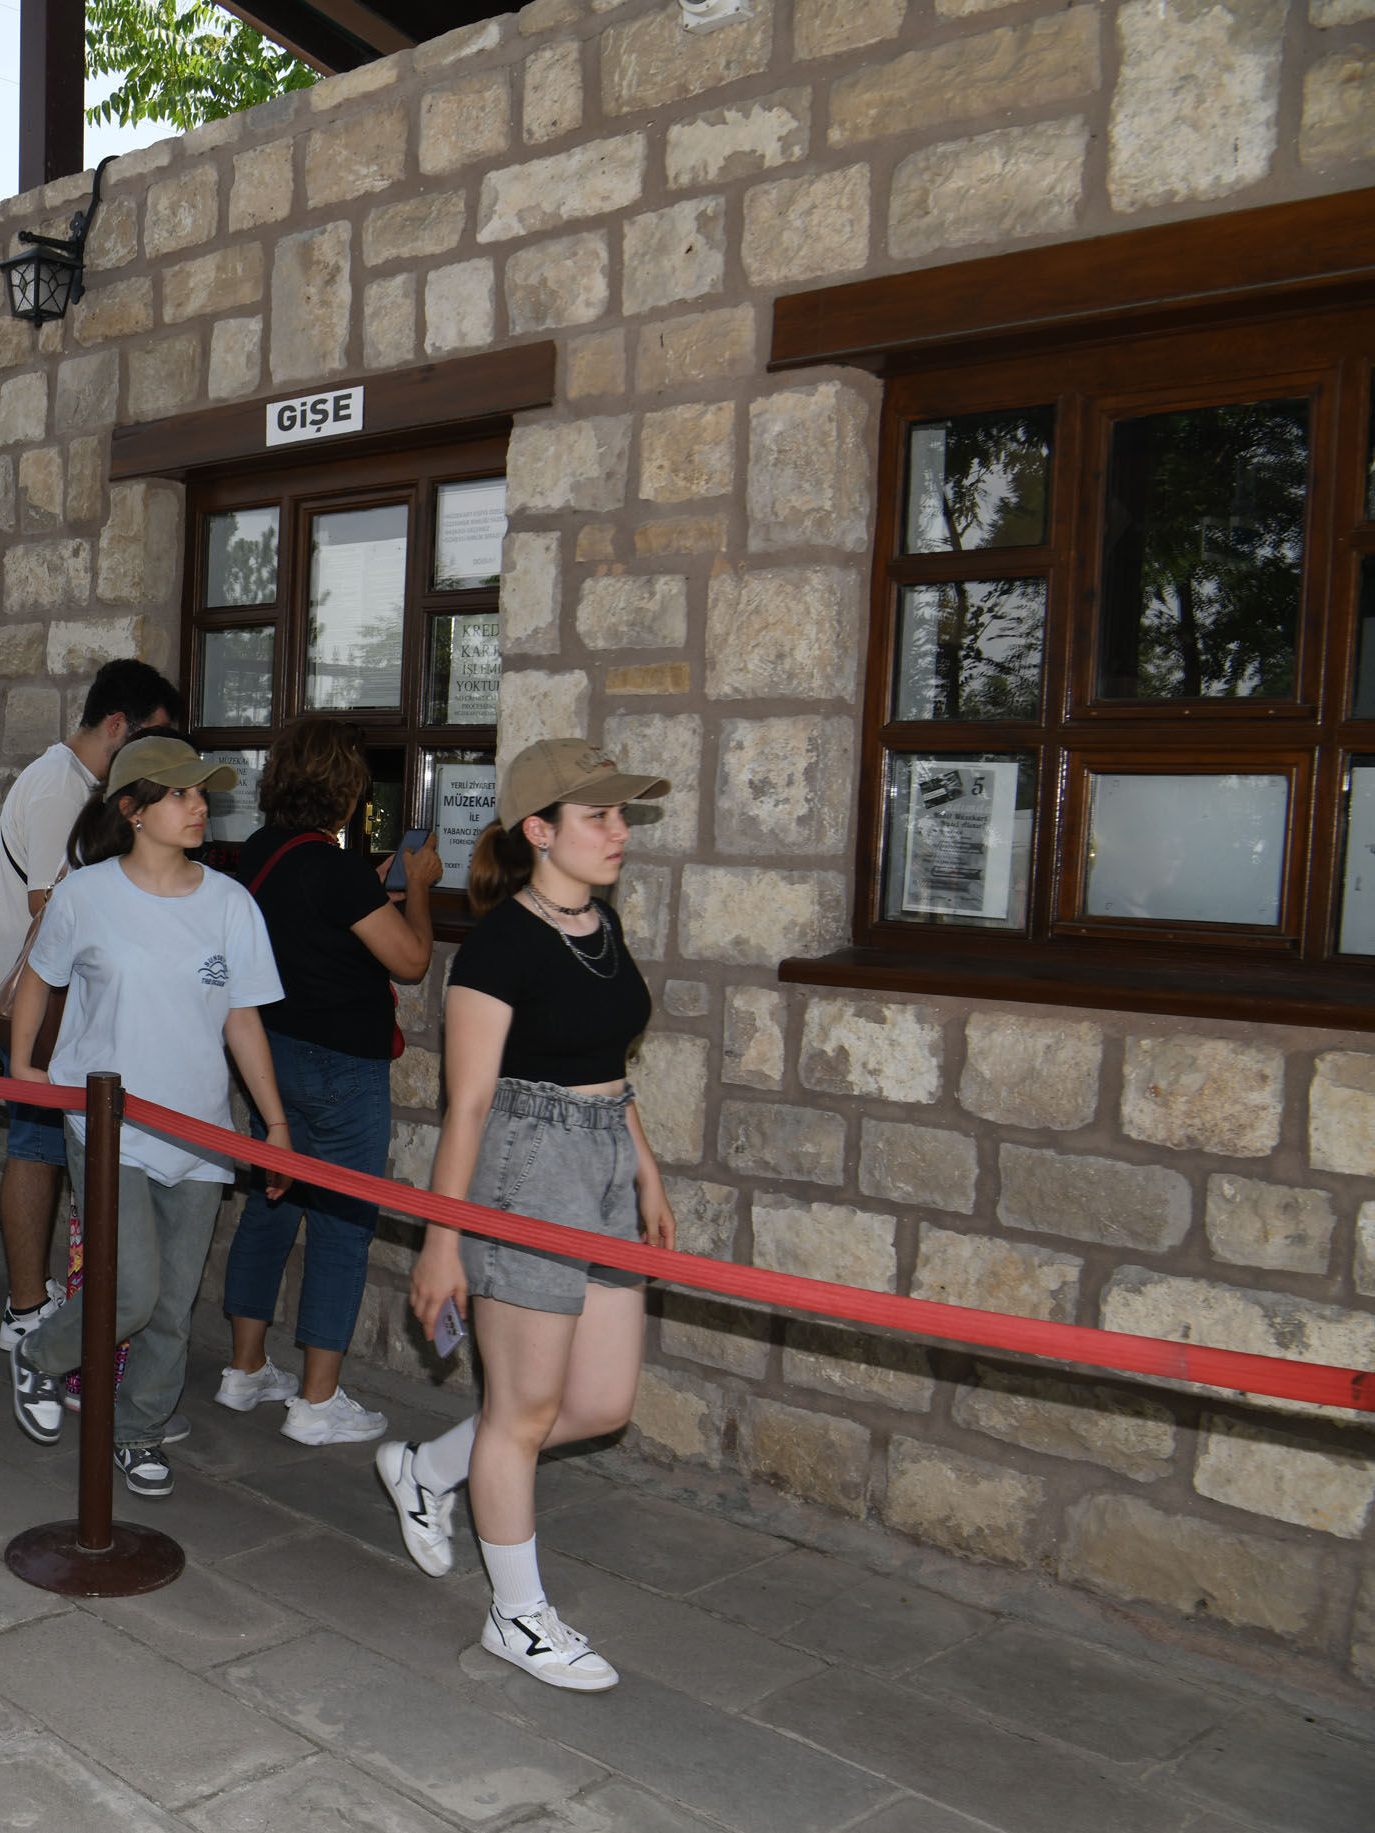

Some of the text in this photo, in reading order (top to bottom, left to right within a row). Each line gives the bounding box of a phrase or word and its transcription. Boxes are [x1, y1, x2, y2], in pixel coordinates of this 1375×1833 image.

[462, 624, 499, 638] KRED
[461, 644, 500, 657] KART
[469, 780, 495, 789] ZİYARET
[971, 777, 985, 795] 5
[443, 793, 495, 808] MÜZEKAR
